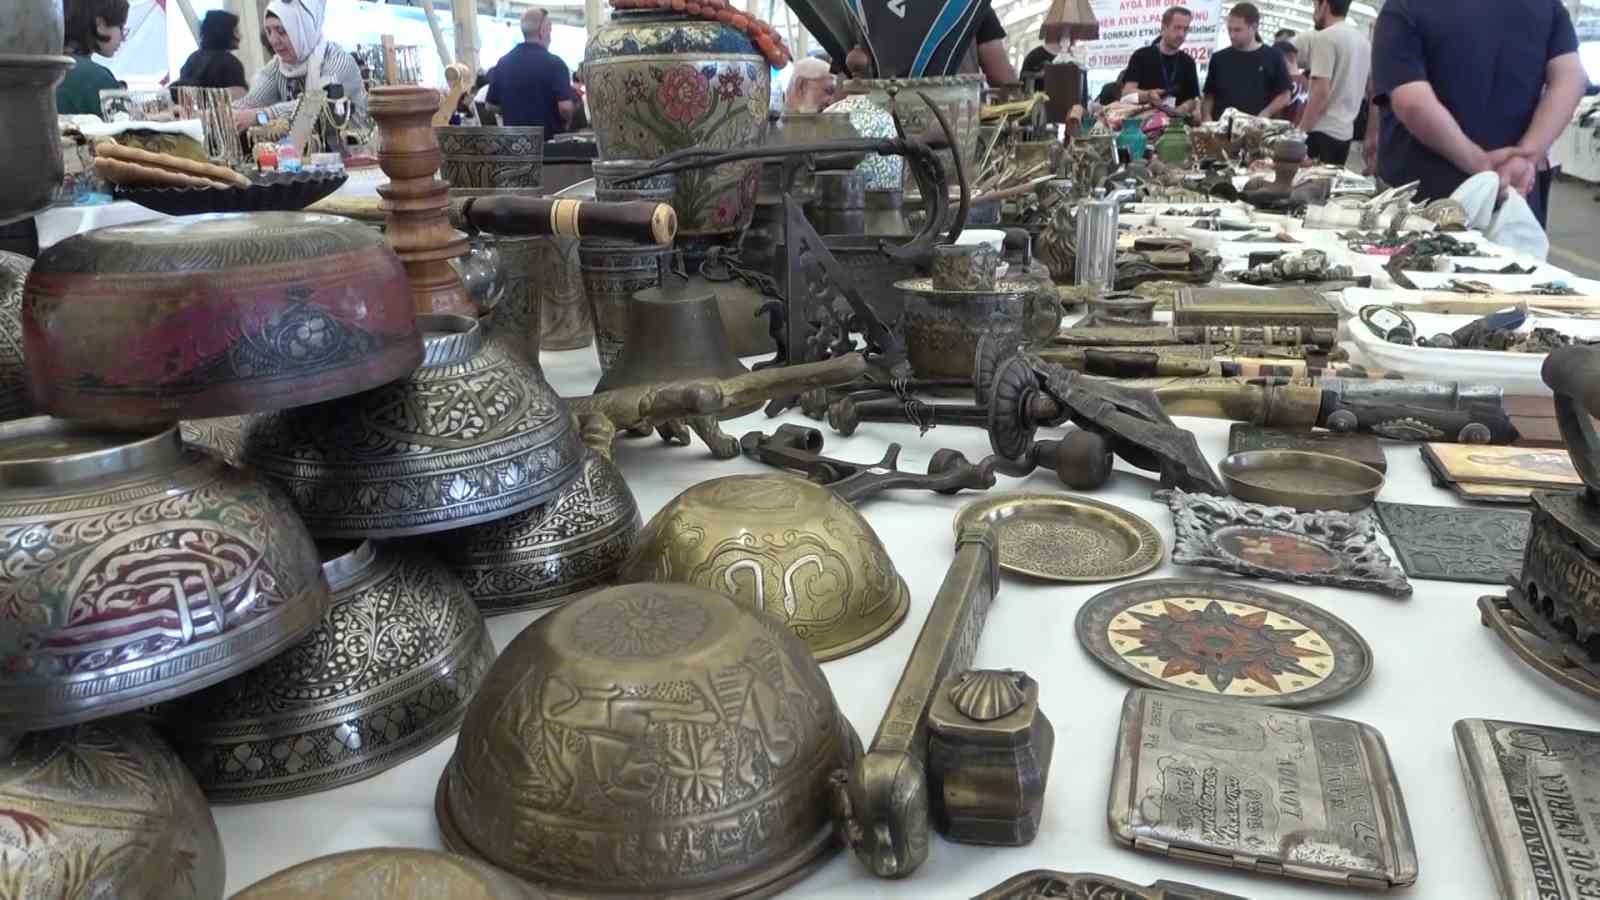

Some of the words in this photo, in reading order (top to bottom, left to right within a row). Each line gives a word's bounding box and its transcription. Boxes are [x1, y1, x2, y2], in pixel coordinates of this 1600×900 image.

[1118, 16, 1138, 26] AYIN
[1142, 14, 1161, 25] 3.PA
[1120, 0, 1143, 10] AYDA
[1278, 756, 1304, 820] LONDON
[1538, 774, 1590, 845] AMERICA
